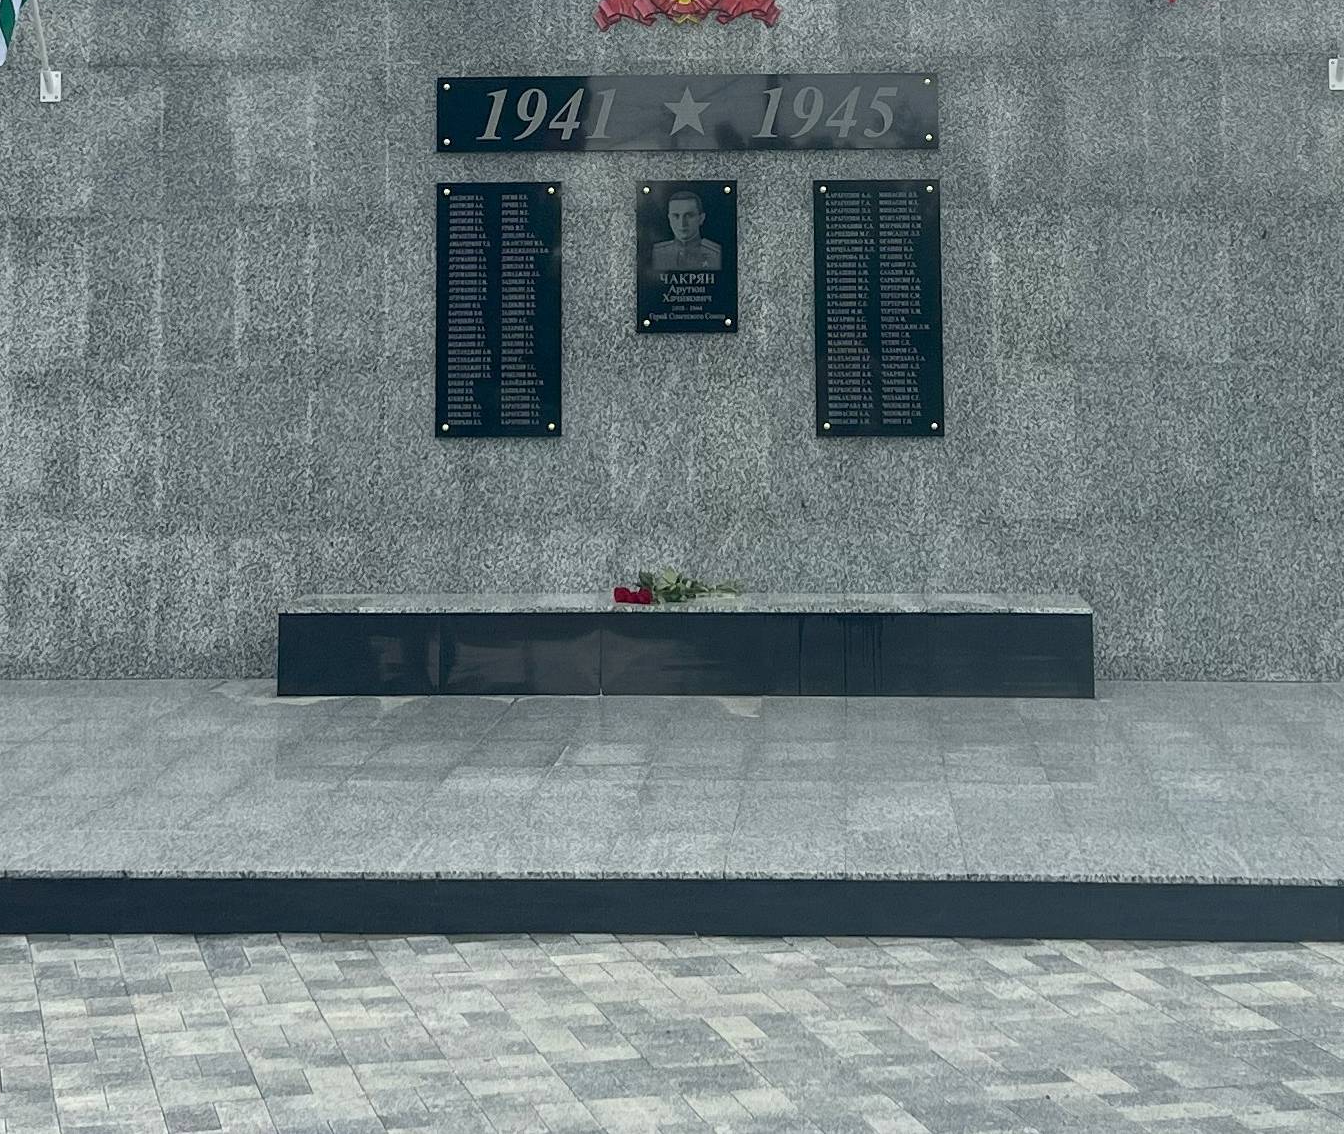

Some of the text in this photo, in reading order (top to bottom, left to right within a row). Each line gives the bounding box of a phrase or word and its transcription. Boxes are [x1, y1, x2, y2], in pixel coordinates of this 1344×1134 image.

[475, 86, 899, 142] 1941 1945
[659, 273, 715, 284] ЧАКРЯН
[668, 284, 706, 295] Арутюн
